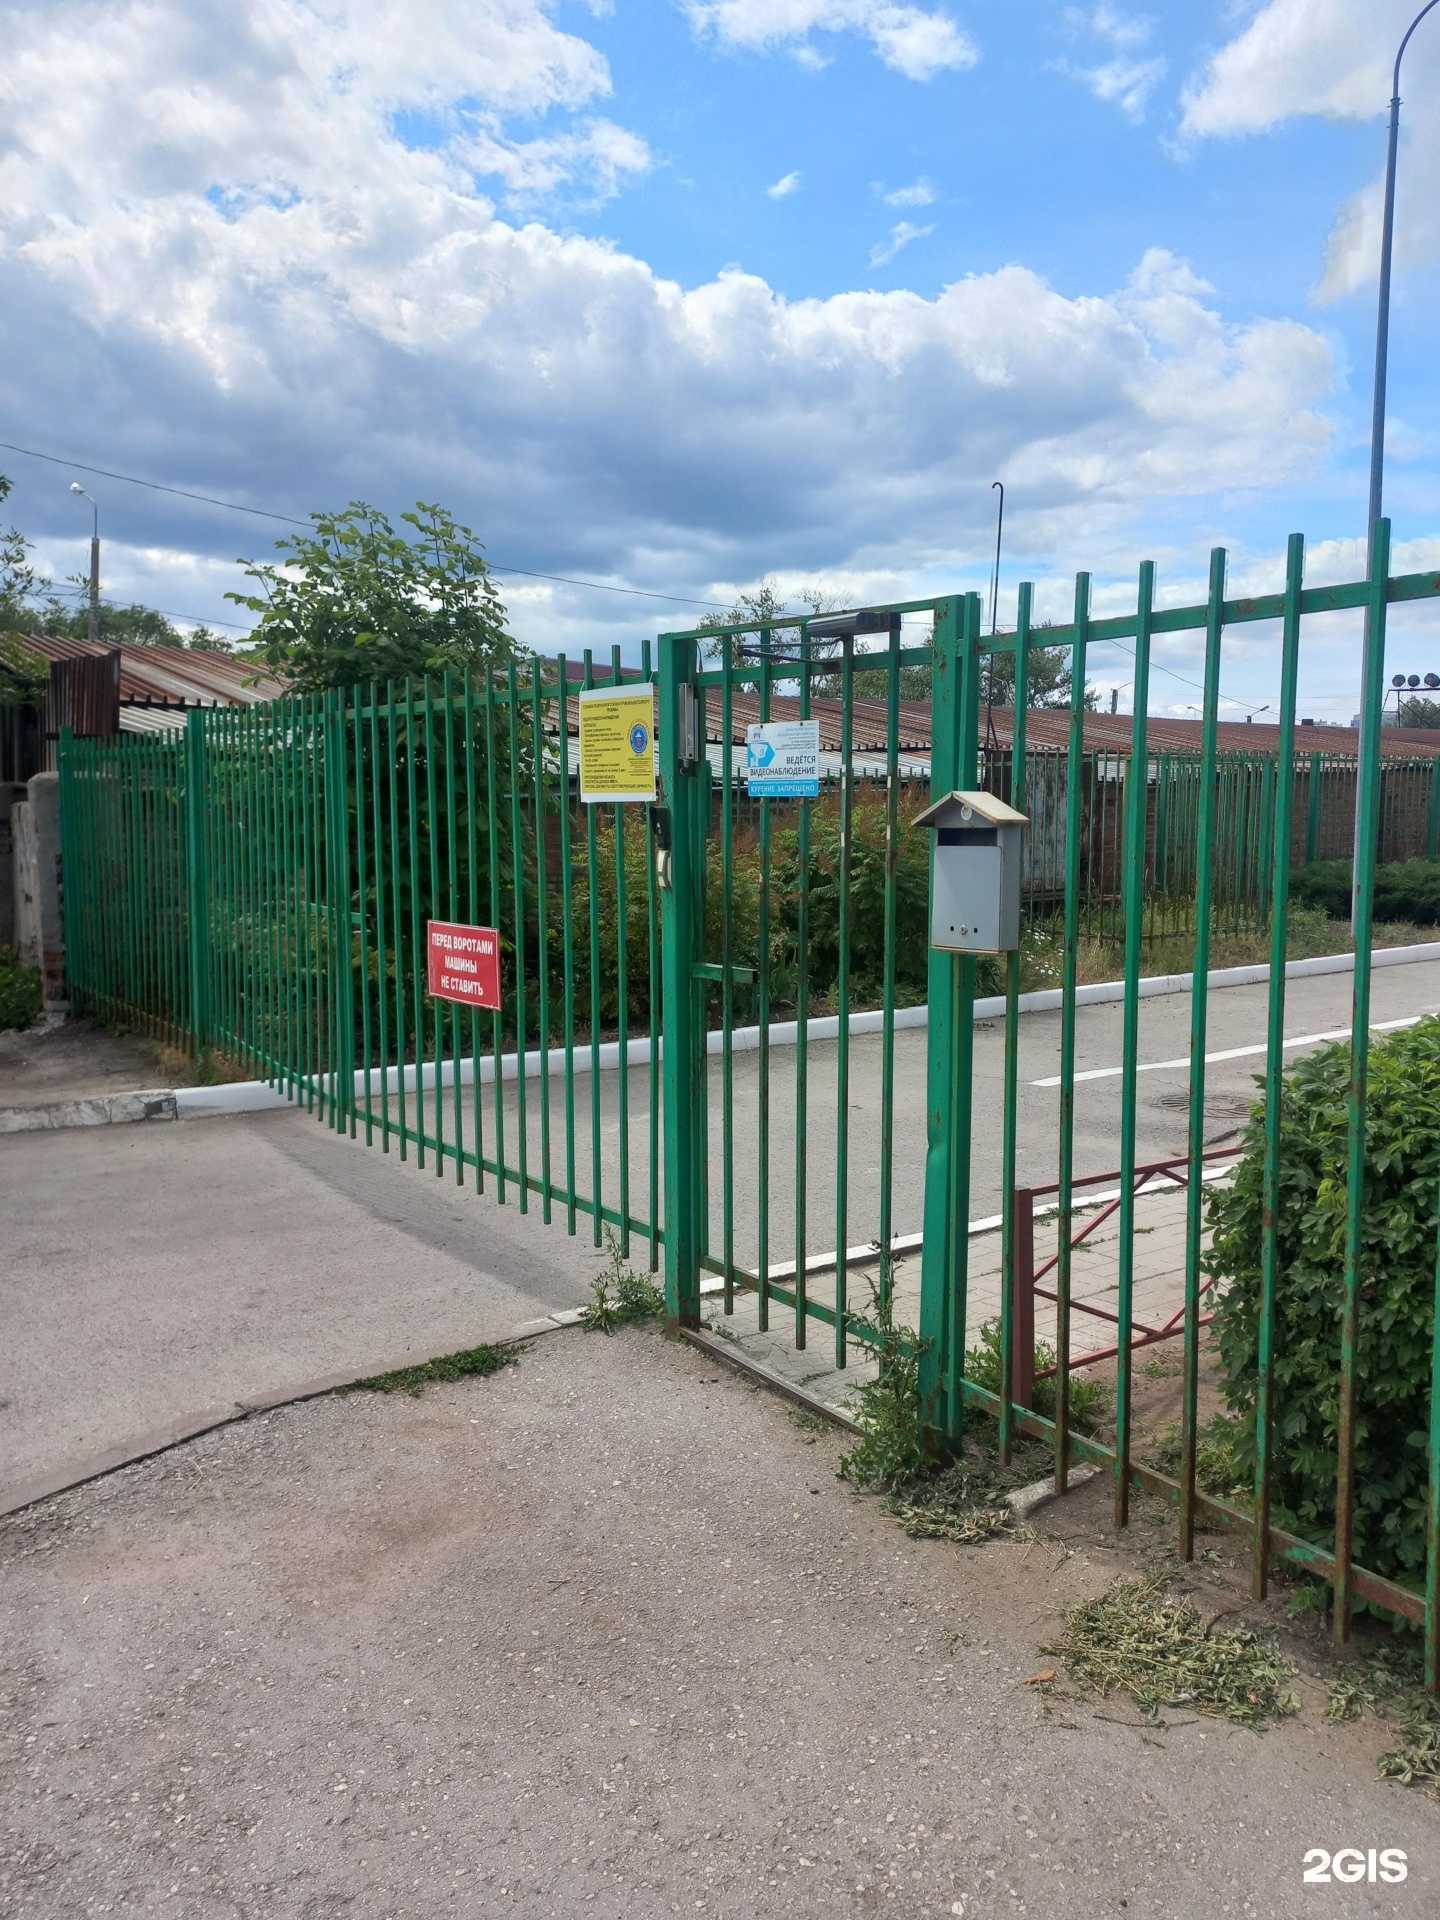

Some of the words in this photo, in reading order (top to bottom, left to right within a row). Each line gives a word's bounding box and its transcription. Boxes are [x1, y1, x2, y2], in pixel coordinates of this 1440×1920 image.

[786, 754, 816, 765] ВЕДЁТСЯ
[750, 767, 816, 777] ВИДЕОНАБЛЮДЕНИЕ
[778, 784, 815, 792] ЗАПРЕЩЕНО
[432, 933, 453, 950] ПЕРЕД
[453, 936, 493, 955] ВОРОТАМИ
[445, 955, 477, 973] МАШИНЫ
[441, 975, 449, 989] НЕ
[451, 977, 483, 996] СТАВИТЬ
